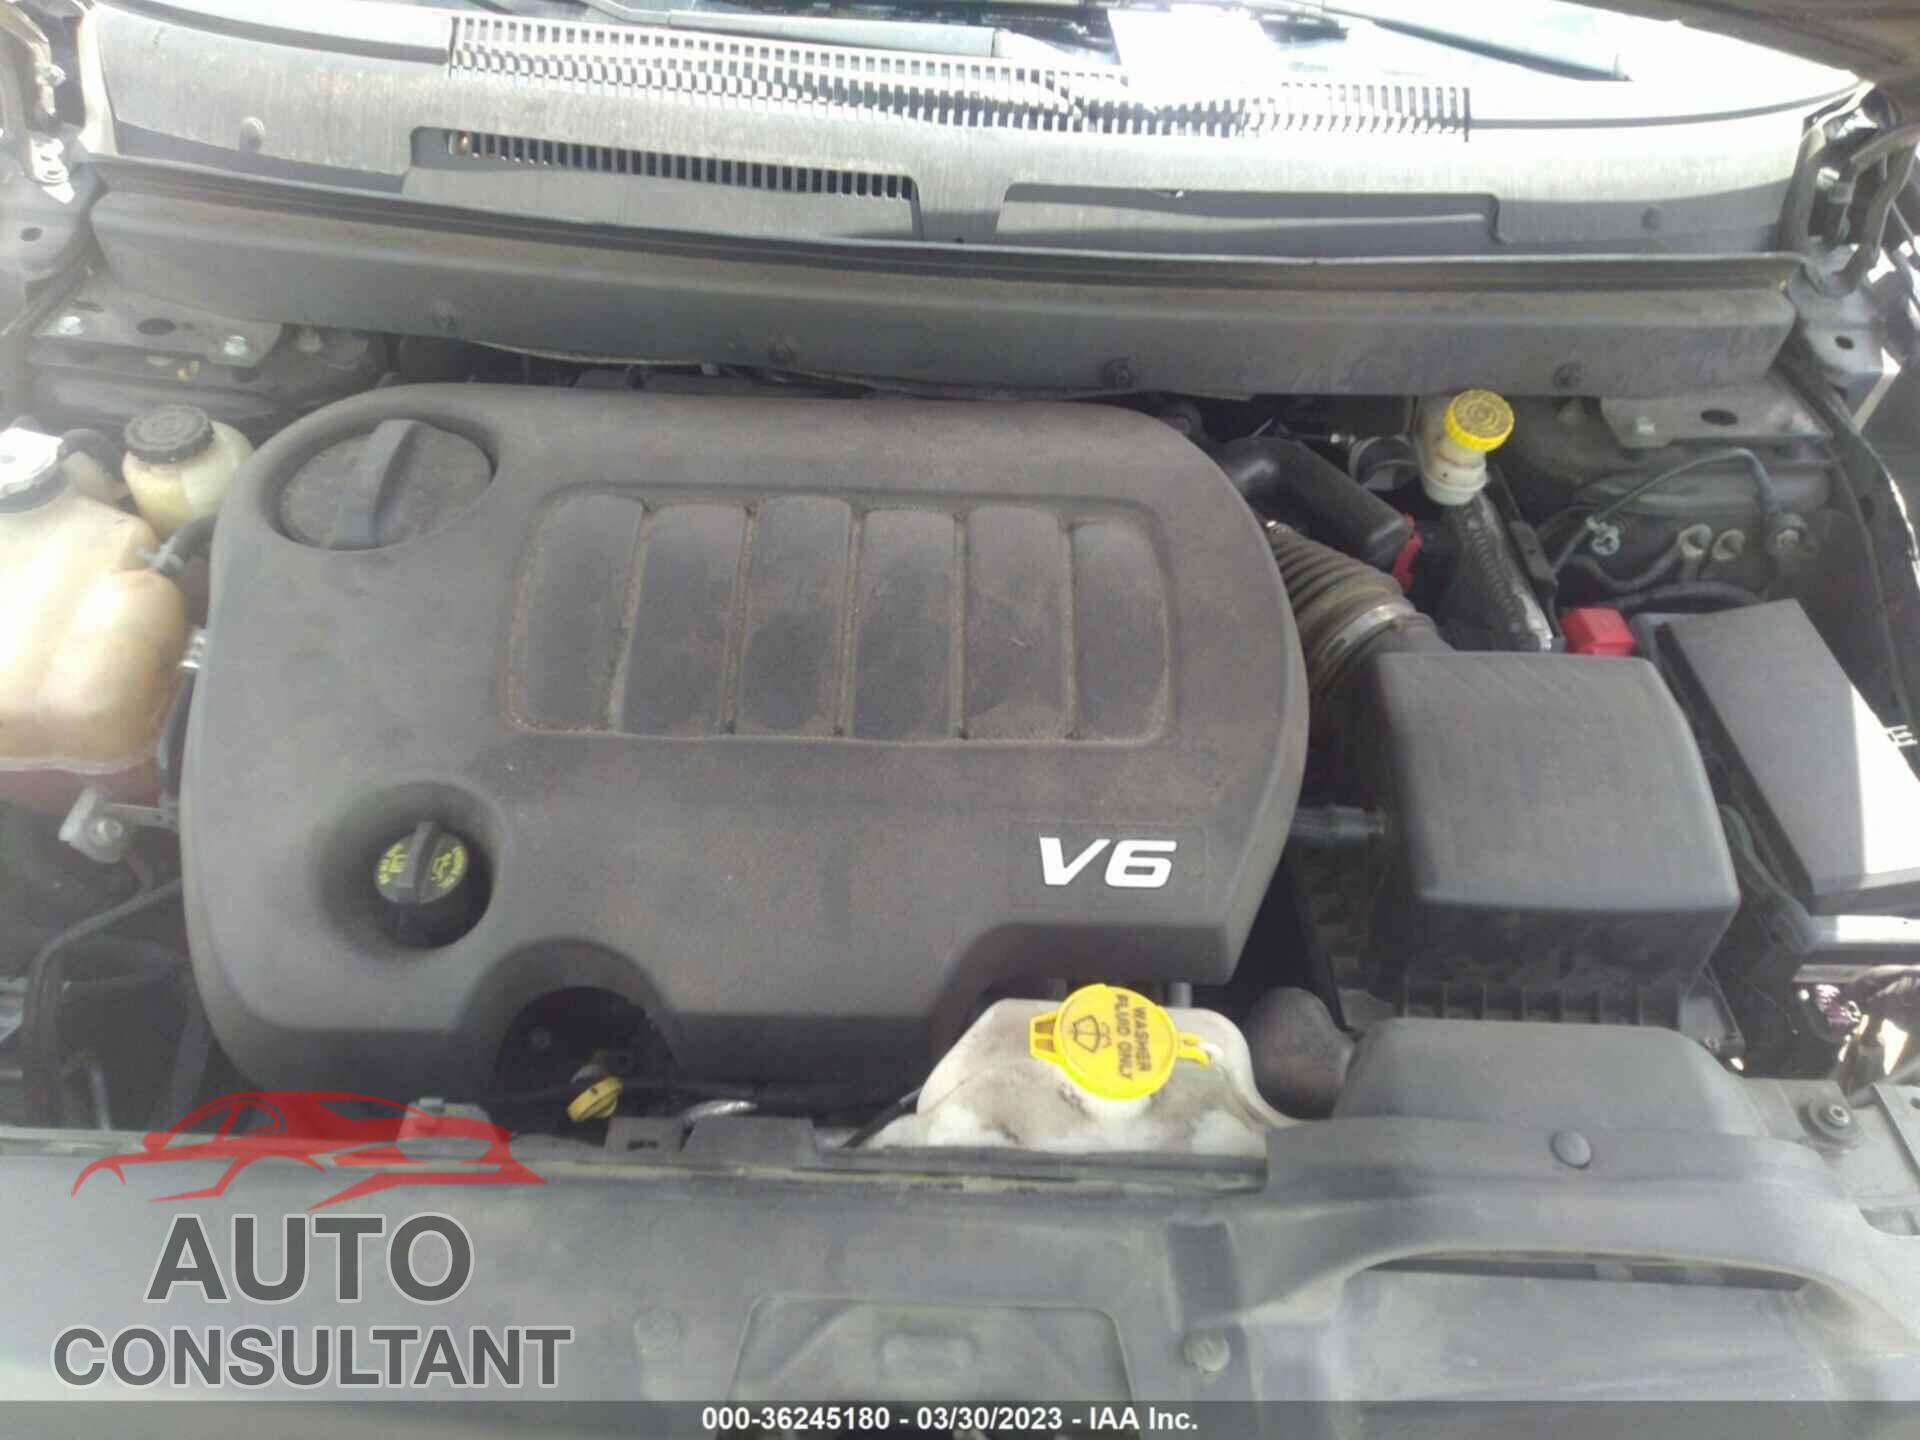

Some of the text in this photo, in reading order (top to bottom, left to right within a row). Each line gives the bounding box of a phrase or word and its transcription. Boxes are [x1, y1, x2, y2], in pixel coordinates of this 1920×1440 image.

[1039, 836, 1178, 889] V6
[1114, 993, 1134, 1082] FLUID ONLY
[1133, 1006, 1153, 1073] WASHER
